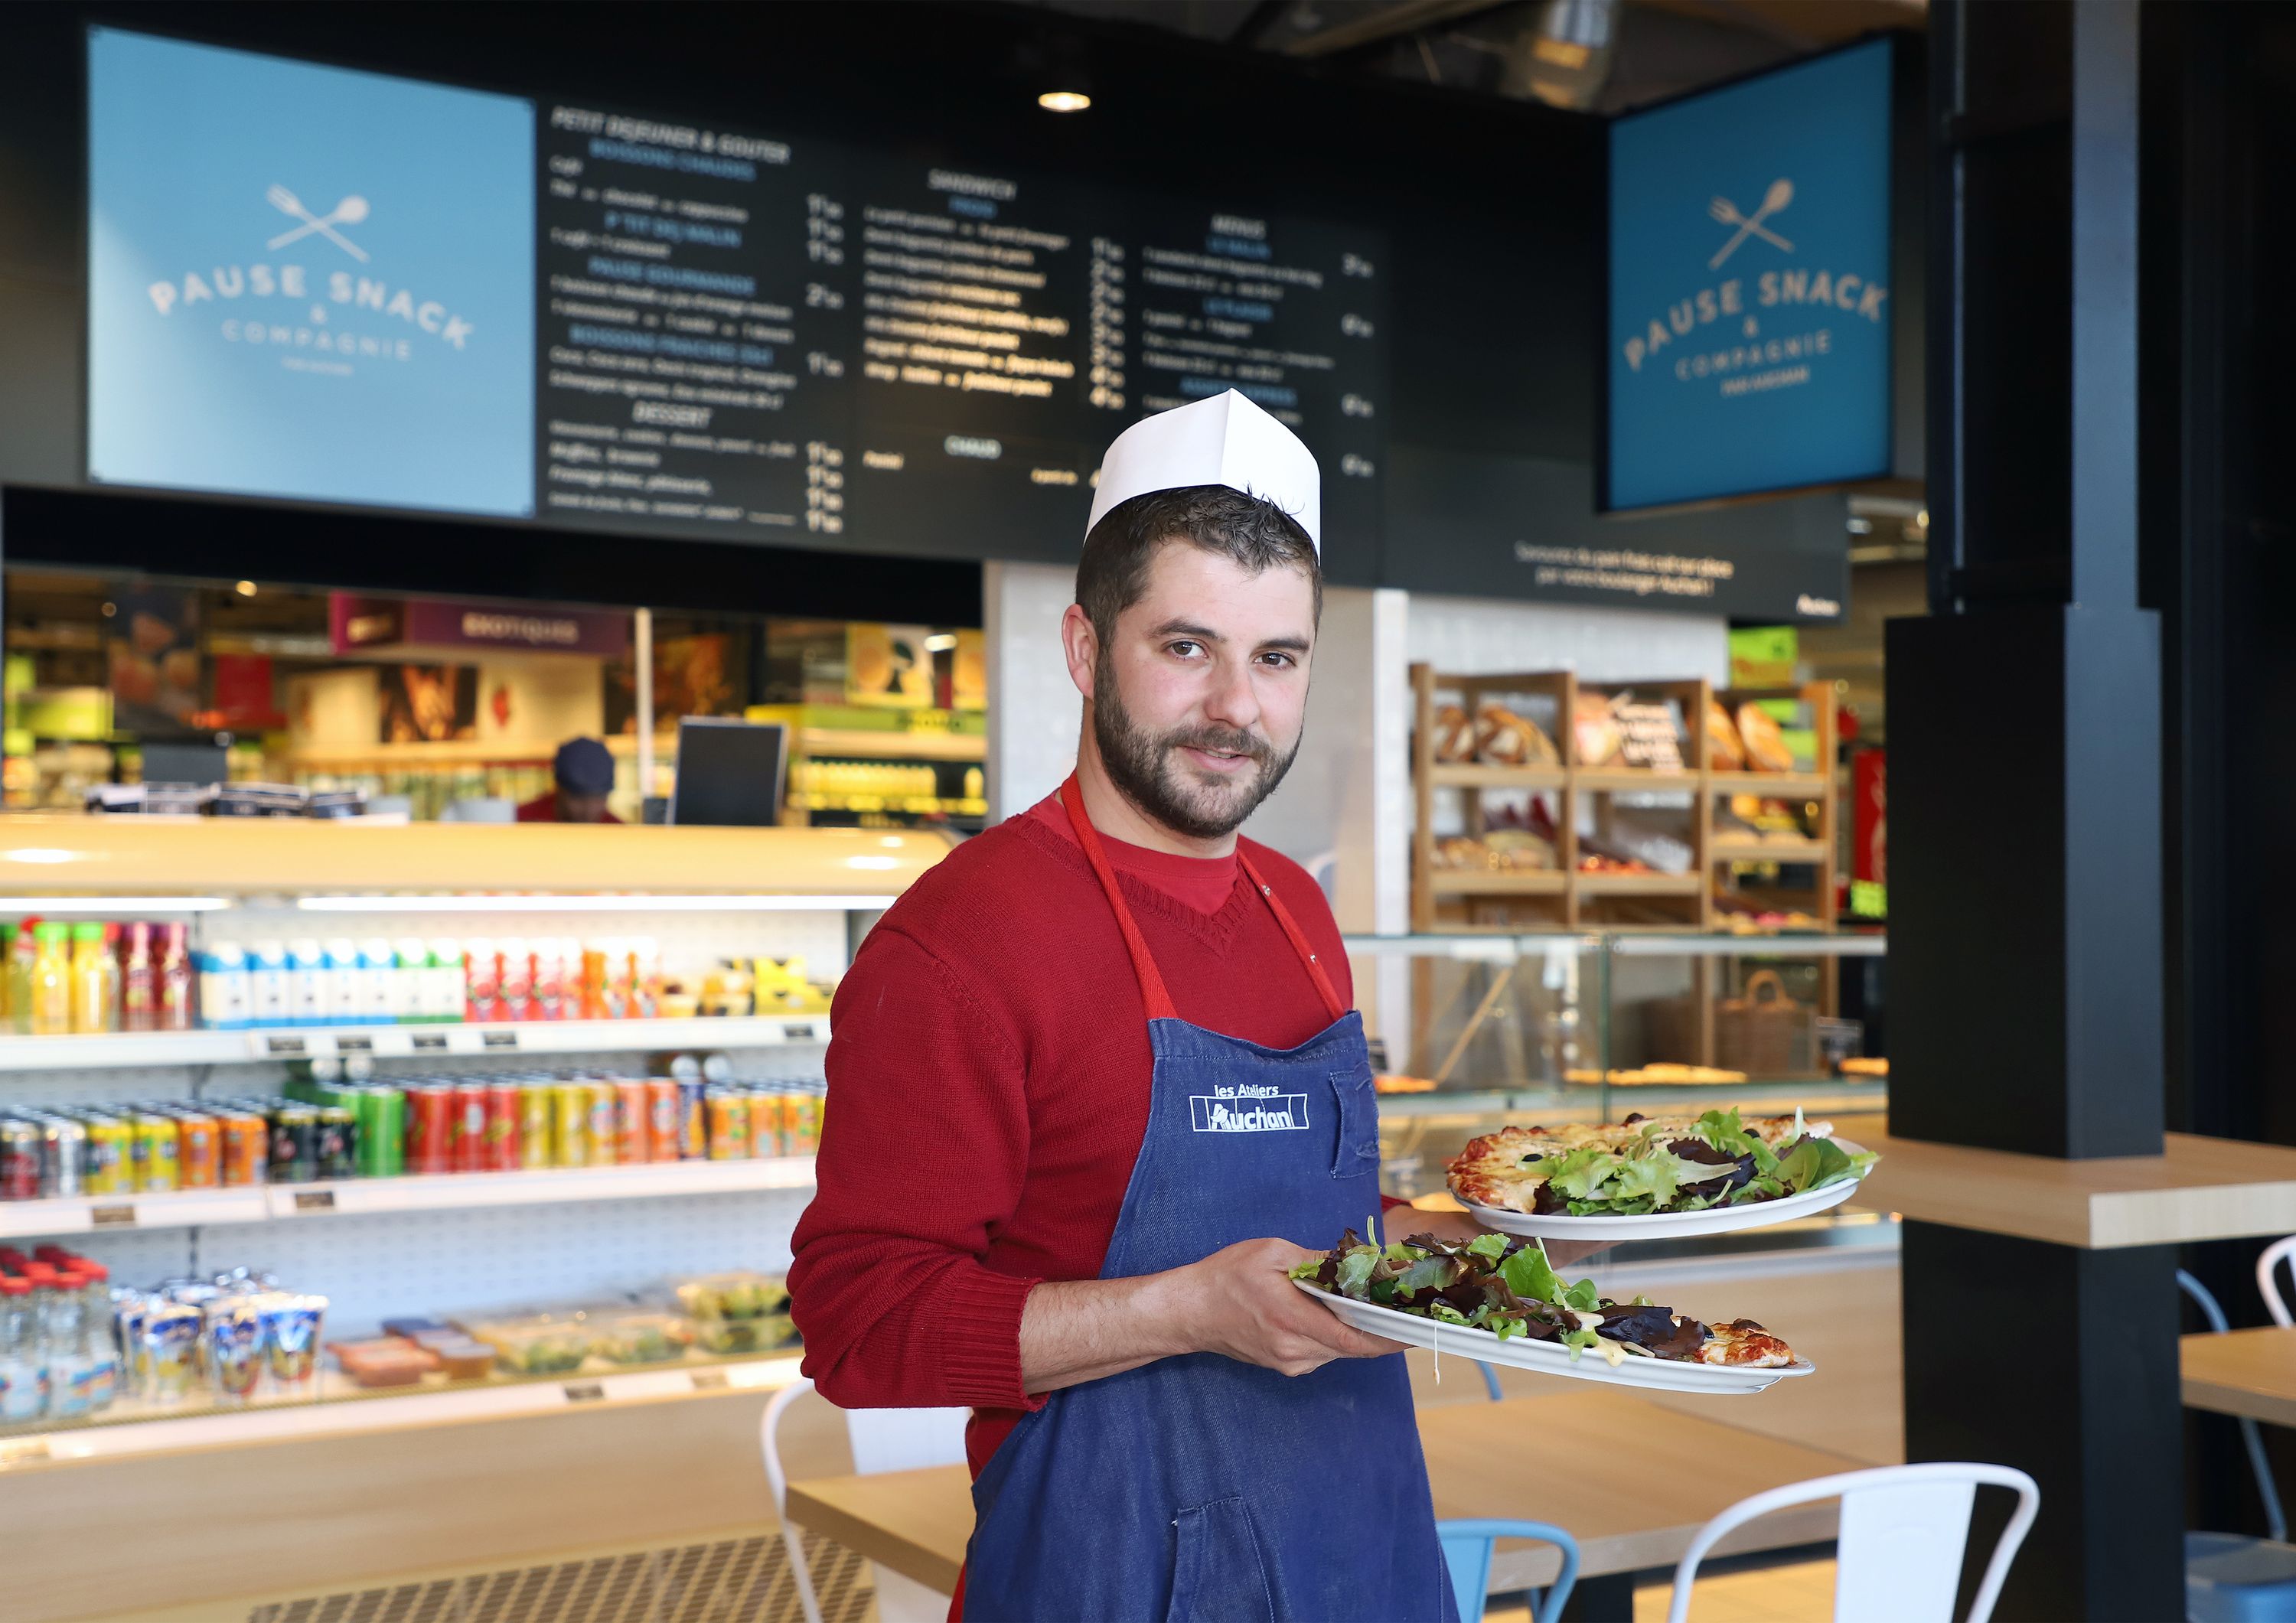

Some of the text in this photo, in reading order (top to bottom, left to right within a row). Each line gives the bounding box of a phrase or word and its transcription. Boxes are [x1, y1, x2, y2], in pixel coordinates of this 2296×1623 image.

[551, 104, 605, 135] PETIT
[717, 133, 791, 165] GOUTER
[148, 264, 475, 350] PAUSE SNACK
[1623, 269, 1889, 372] PAUSE SNACK
[220, 318, 412, 361] COMPAGNIE
[1675, 328, 1831, 382] COMPAGNIE
[632, 399, 713, 429] DESSERT
[1214, 1084, 1234, 1097] les
[1210, 1103, 1293, 1129] Auchan
